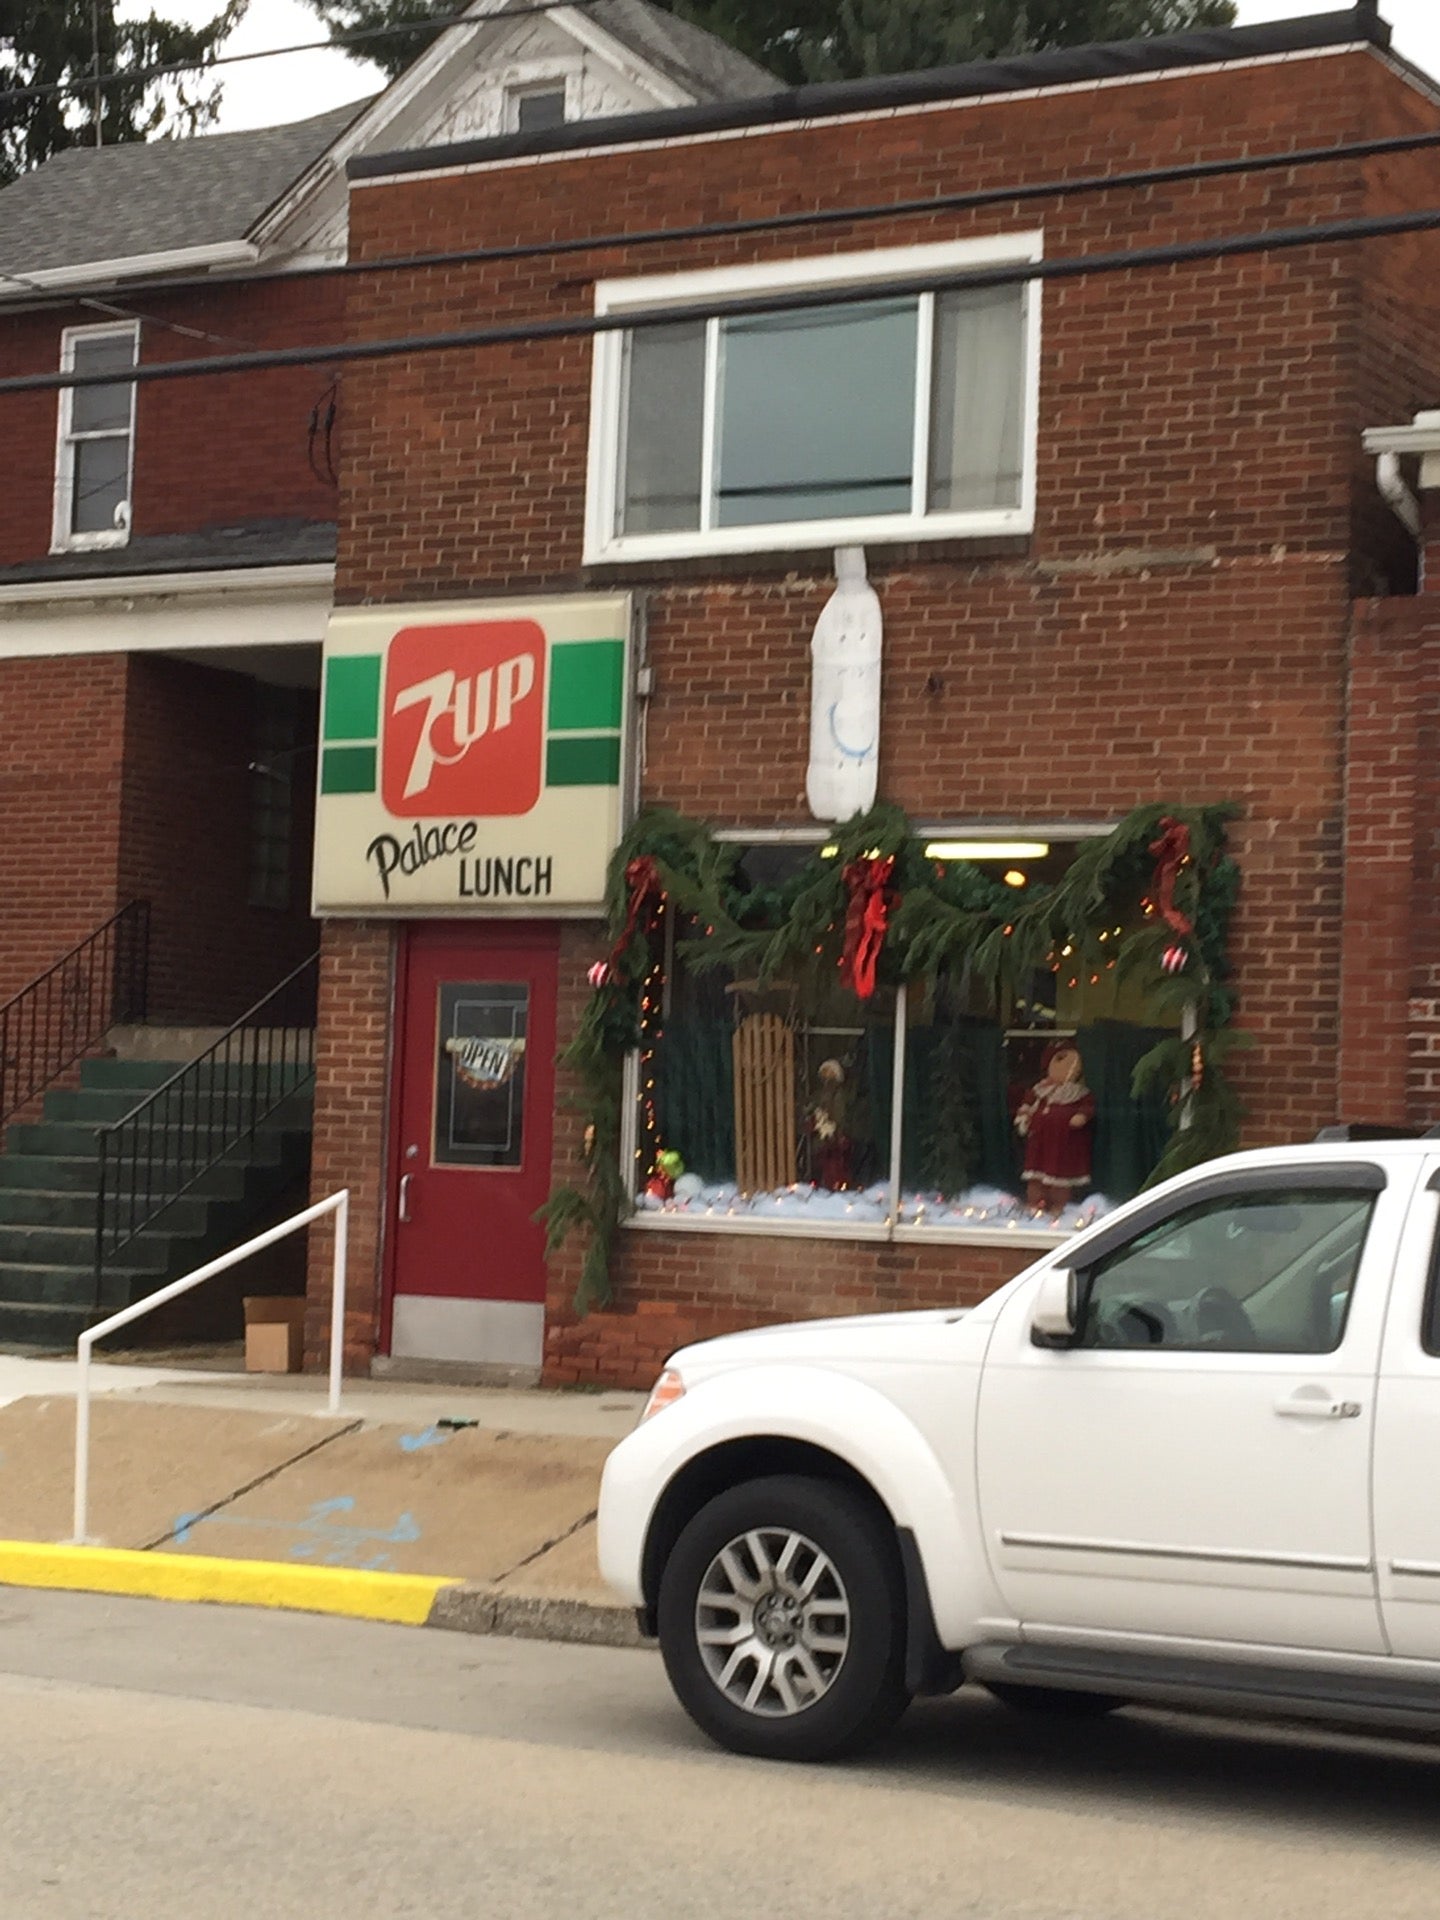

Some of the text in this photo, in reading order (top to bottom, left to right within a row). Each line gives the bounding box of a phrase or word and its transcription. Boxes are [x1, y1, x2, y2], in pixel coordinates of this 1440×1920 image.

[392, 652, 535, 799] 7UP
[366, 820, 477, 899] Palace
[459, 855, 552, 897] LUNCH
[461, 1041, 505, 1075] OPEN
